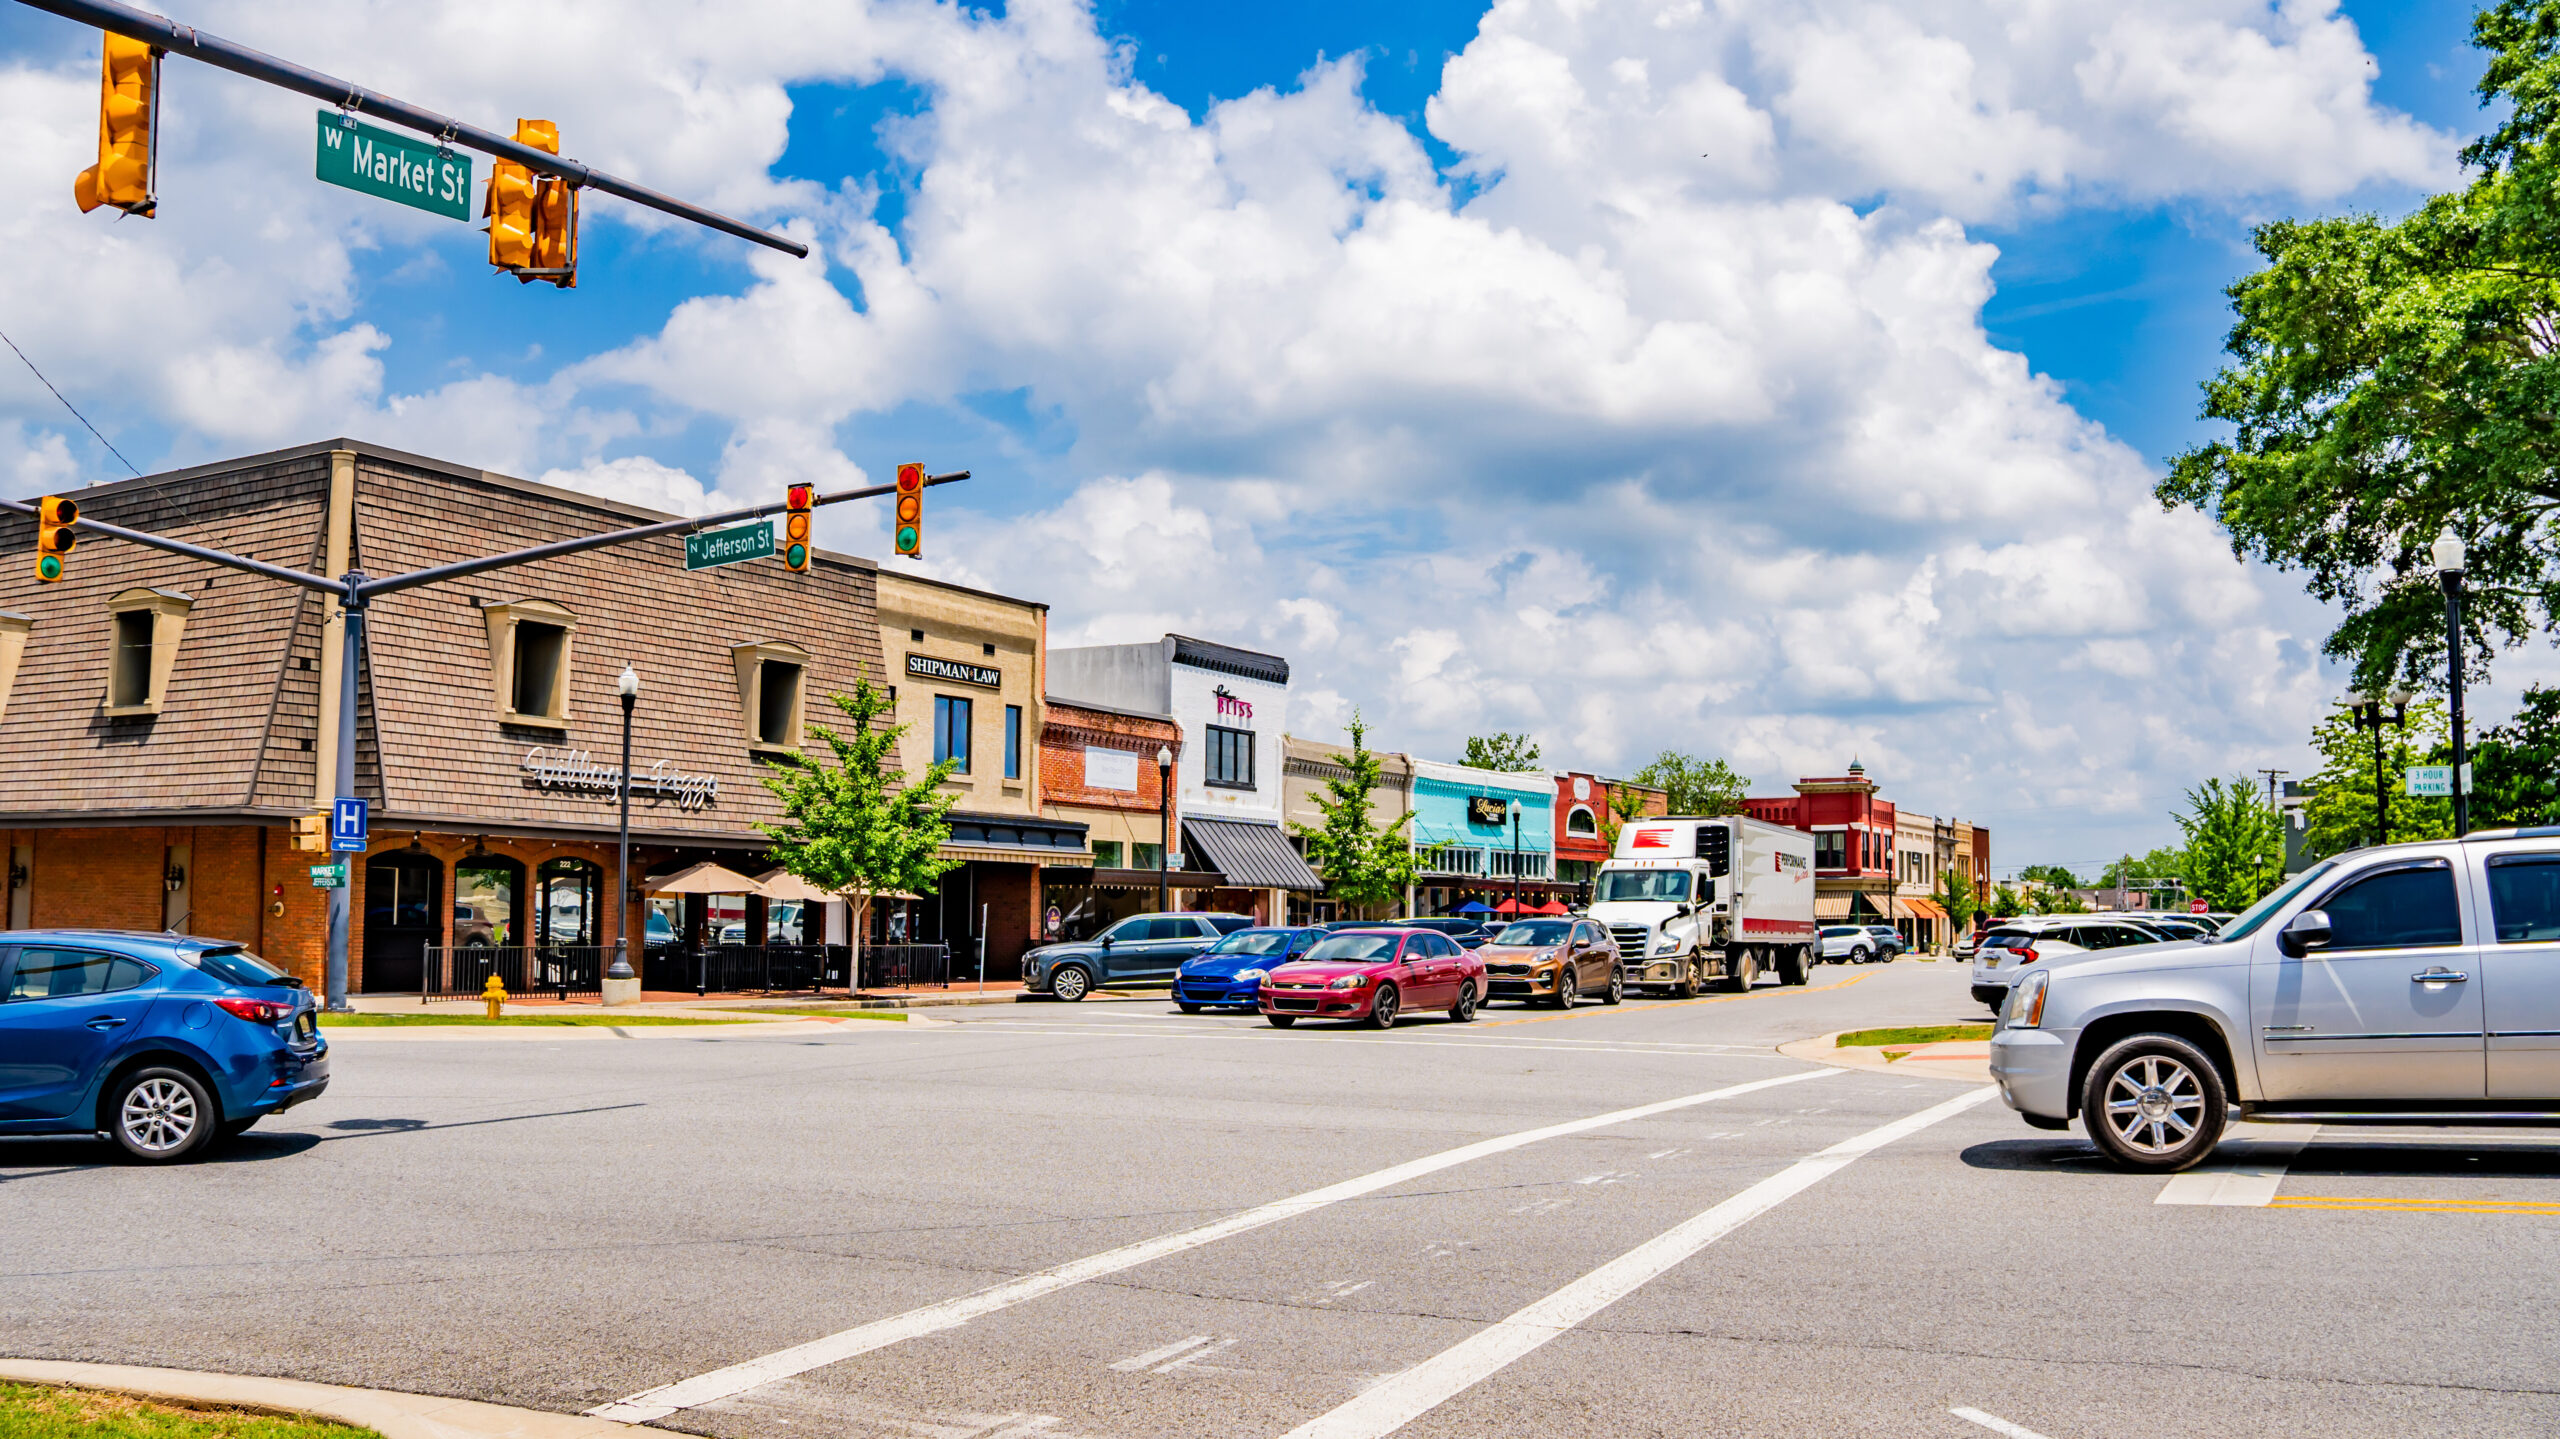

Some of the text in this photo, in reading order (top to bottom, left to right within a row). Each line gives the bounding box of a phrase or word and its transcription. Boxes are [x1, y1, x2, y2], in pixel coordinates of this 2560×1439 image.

[324, 125, 465, 205] W Market St
[690, 528, 770, 560] N Jefferson St
[909, 656, 999, 685] SHIPMAN LAW
[1217, 696, 1253, 718] BLISS
[525, 747, 632, 801] Villag
[2415, 770, 2444, 780] 3 HOUR
[2414, 782, 2446, 792] PARKING
[340, 803, 361, 834] H
[1475, 798, 1506, 820] Lucia's
[311, 865, 336, 876] MARKET
[559, 860, 571, 868] 222
[312, 877, 338, 887] JEFFERSON
[2191, 903, 2207, 912] STOP
